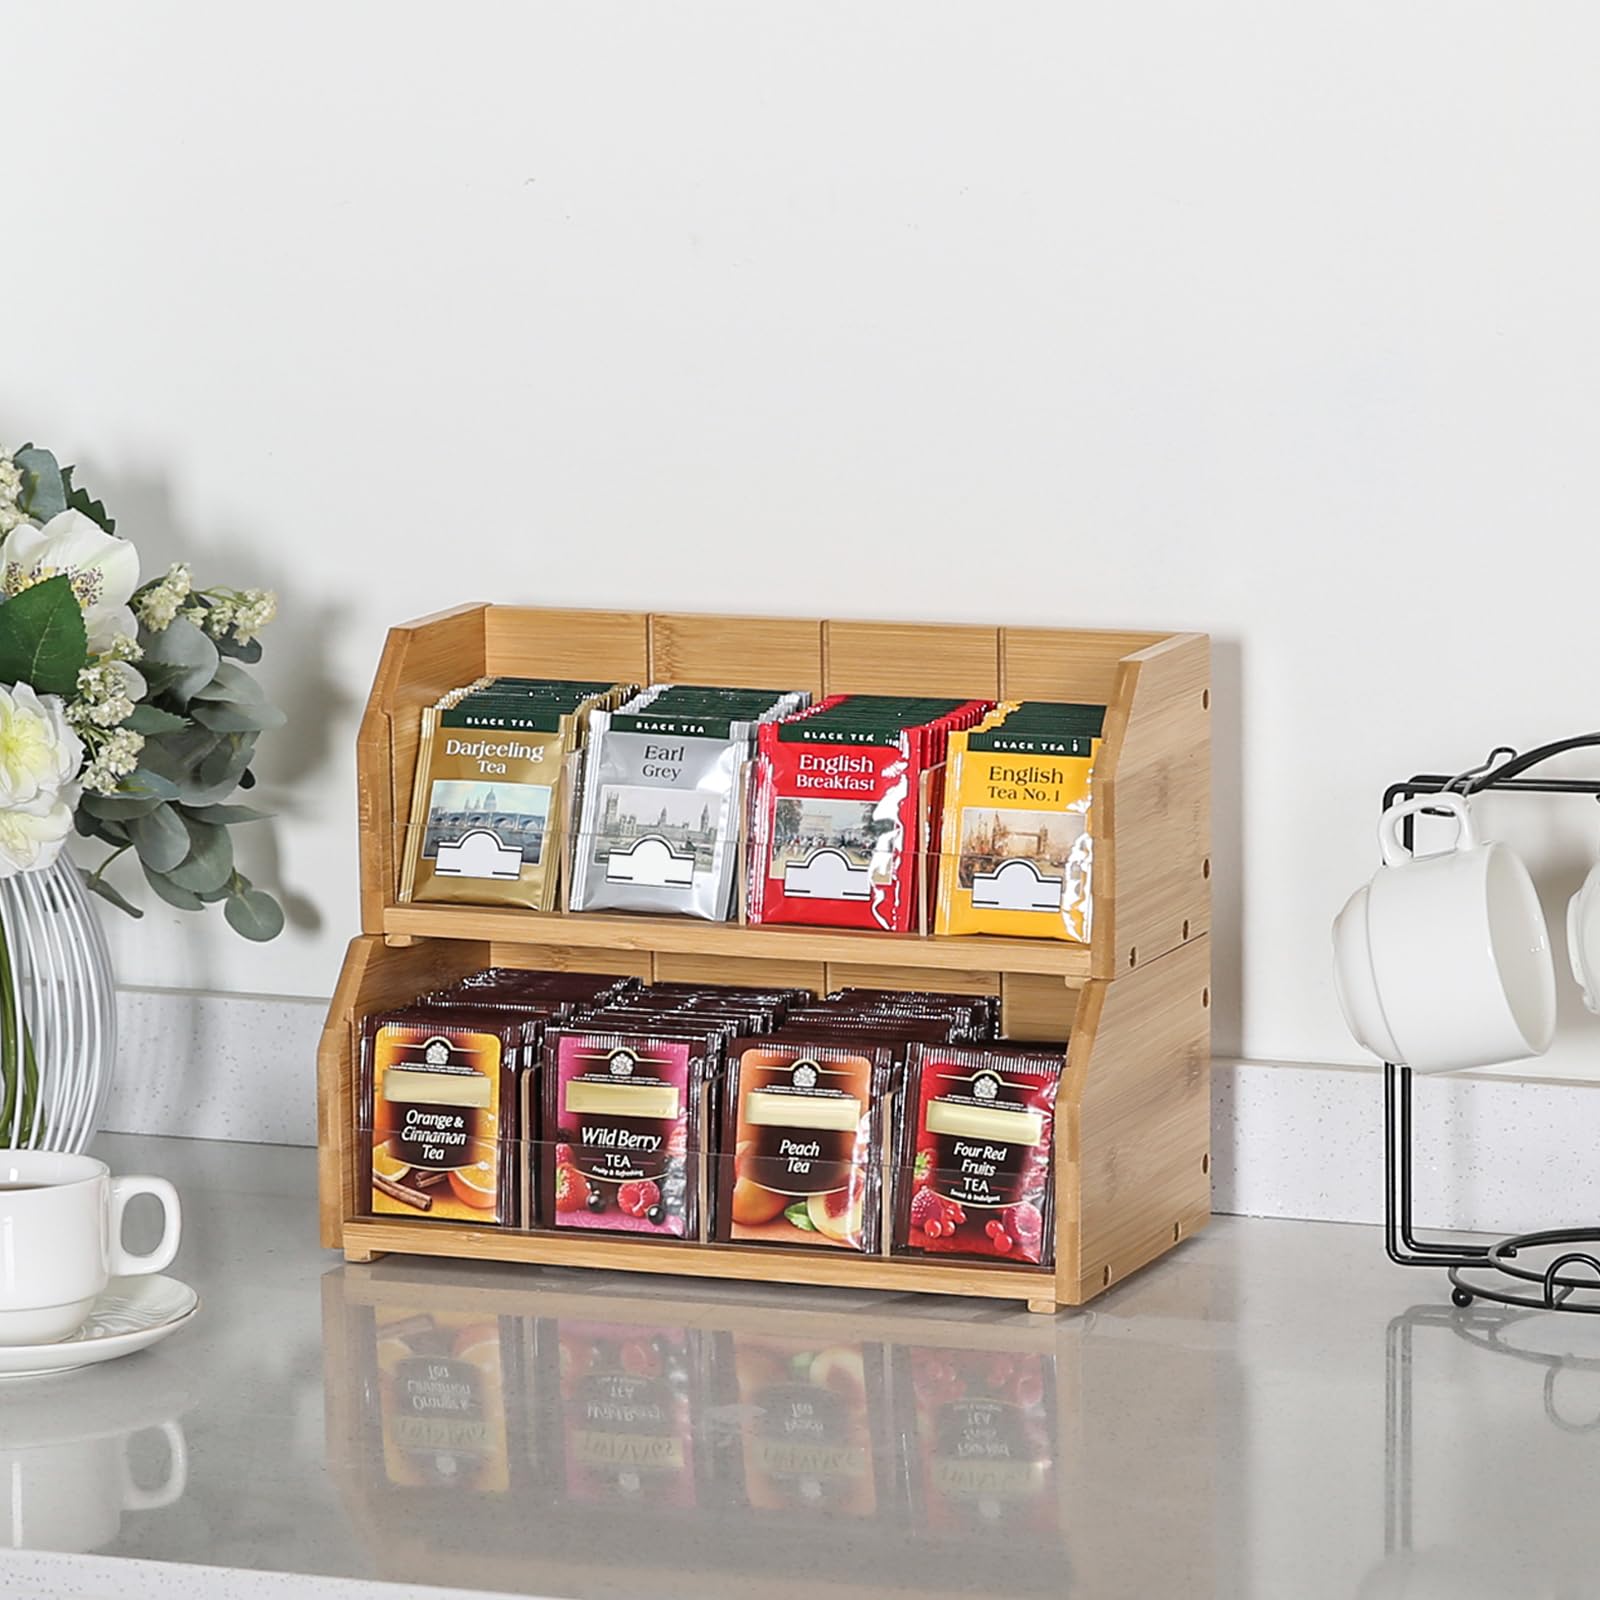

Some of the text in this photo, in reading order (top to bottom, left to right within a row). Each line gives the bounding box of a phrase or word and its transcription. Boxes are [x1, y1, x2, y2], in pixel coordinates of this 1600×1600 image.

[466, 716, 534, 728] BLACK TEA
[635, 721, 705, 733] BLACK TEA
[803, 731, 875, 742] BLACK TEA
[445, 739, 544, 763] Darjeeling
[644, 745, 684, 761] Earl
[994, 740, 1065, 752] BLACK TEA
[476, 760, 507, 775] Tea
[642, 764, 682, 782] Grey
[799, 754, 874, 777] English
[796, 774, 876, 791] Breakfast
[988, 766, 1064, 786] English
[987, 786, 1018, 800] Tea
[1022, 788, 1051, 802] No.
[405, 1109, 464, 1130] Orange &
[401, 1126, 467, 1146] Cinnamon
[581, 1126, 662, 1153] Wild Berry
[421, 1144, 445, 1160] Tea
[779, 1139, 821, 1157] Peach
[953, 1142, 1007, 1161] Four Red
[605, 1153, 631, 1168] TEA
[787, 1157, 811, 1175] Tea
[961, 1159, 997, 1176] Fruits
[963, 1177, 989, 1193] TEA
